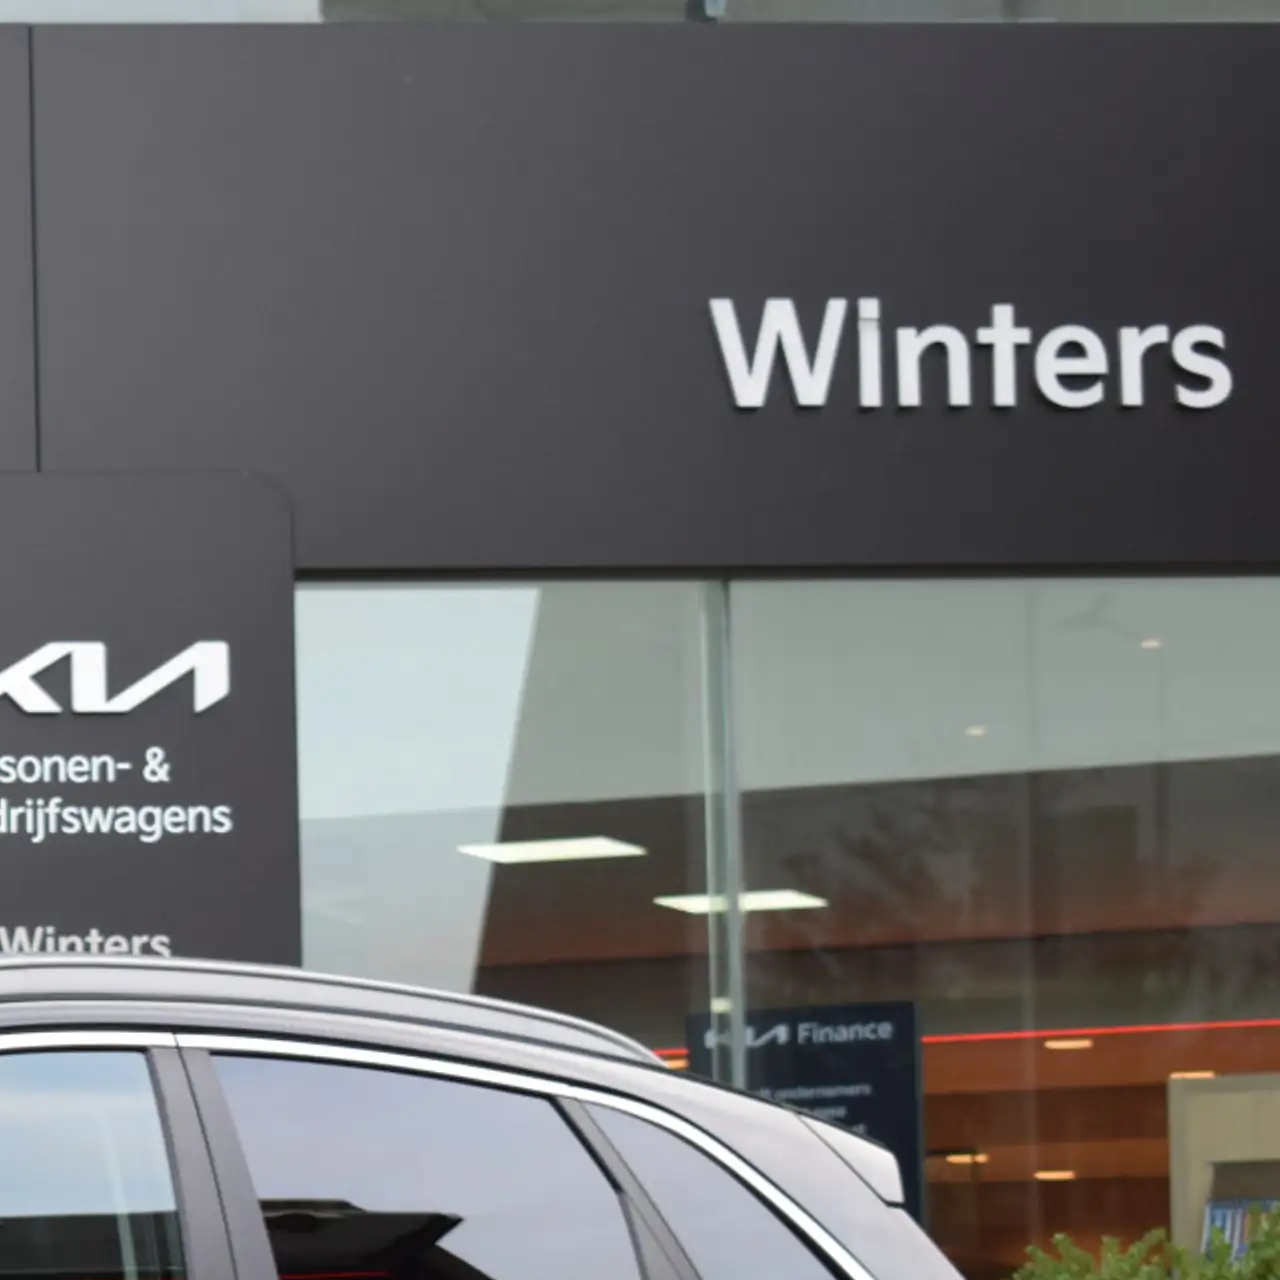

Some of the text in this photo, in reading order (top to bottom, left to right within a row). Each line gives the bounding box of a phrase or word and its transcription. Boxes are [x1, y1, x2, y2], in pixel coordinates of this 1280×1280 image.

[709, 297, 1233, 408] Winters
[143, 746, 171, 783] &
[797, 1020, 893, 1045] Finance
